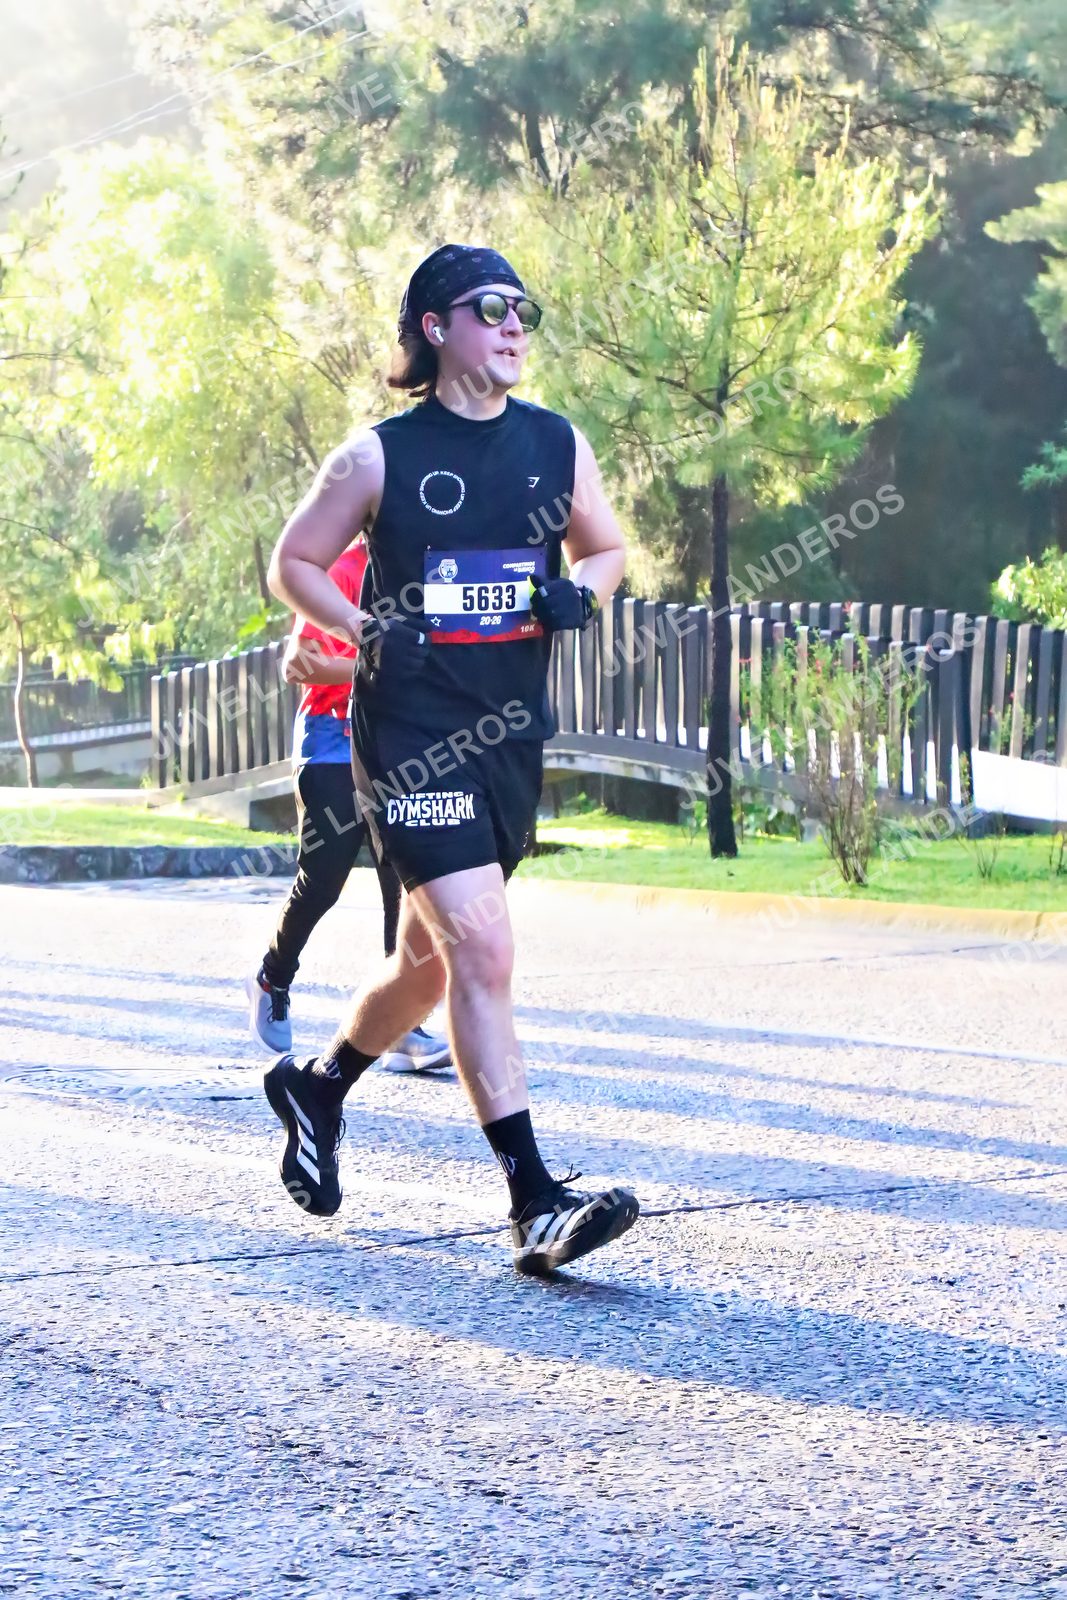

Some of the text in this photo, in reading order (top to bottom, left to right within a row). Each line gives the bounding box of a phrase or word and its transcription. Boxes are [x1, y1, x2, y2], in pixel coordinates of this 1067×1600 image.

[462, 584, 516, 611] 5633
[400, 791, 464, 800] LIFTING
[387, 793, 476, 825] GYMSHARK
[405, 818, 461, 827] CLUB
